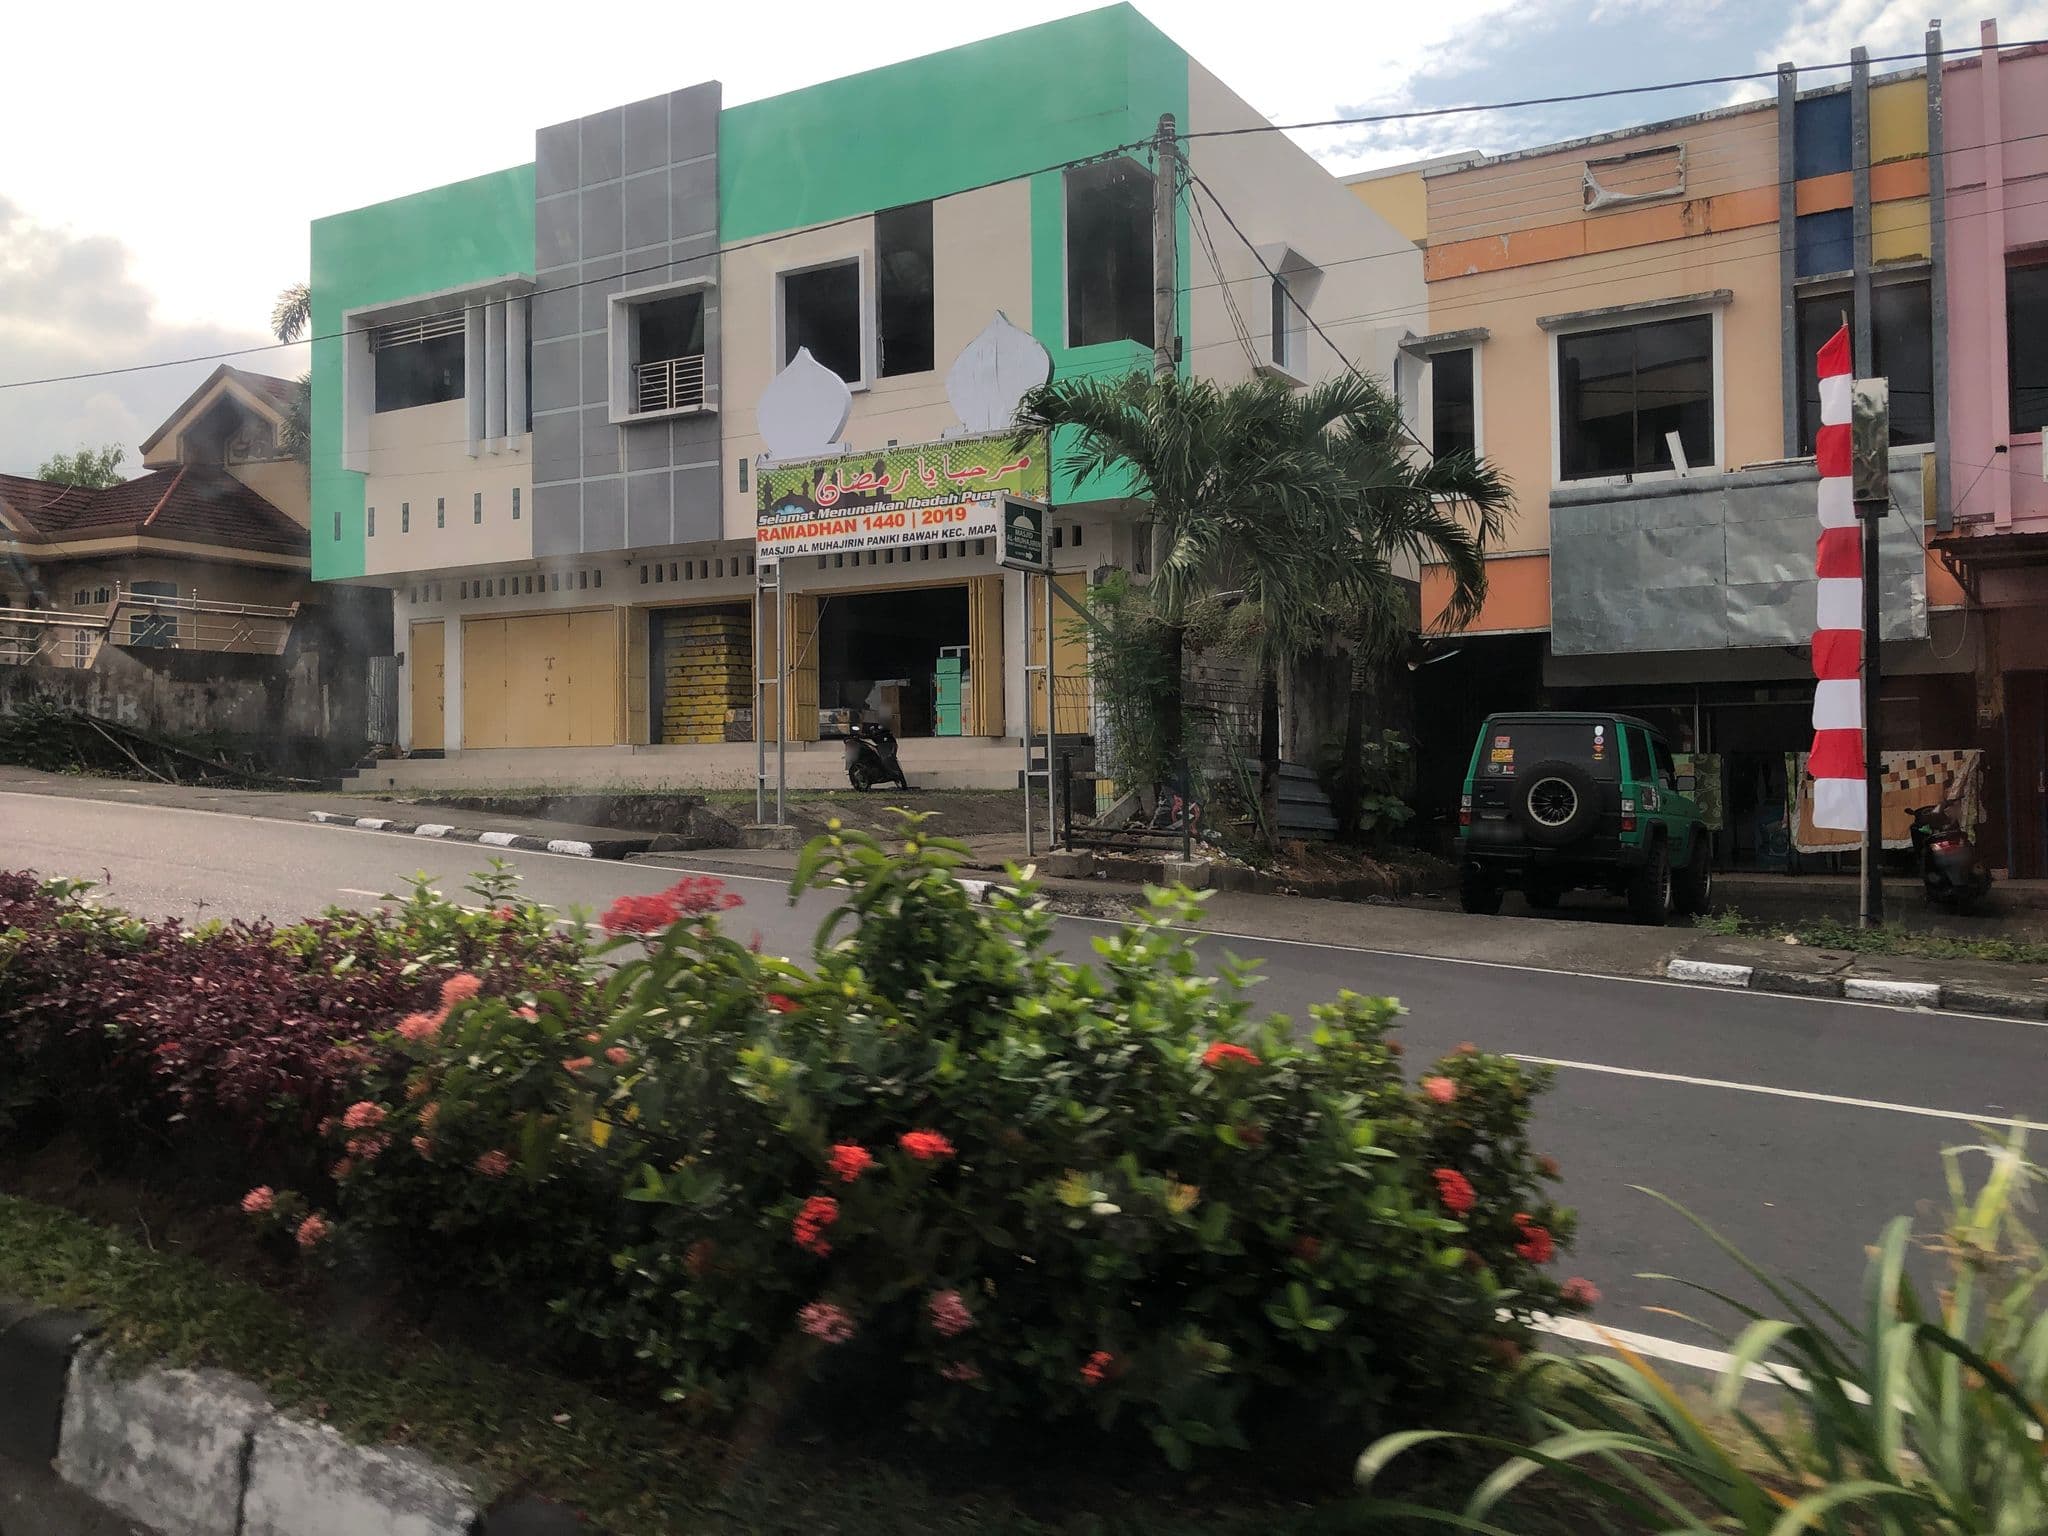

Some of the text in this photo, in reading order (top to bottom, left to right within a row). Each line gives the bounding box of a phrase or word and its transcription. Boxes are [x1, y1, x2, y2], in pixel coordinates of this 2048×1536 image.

[888, 445, 920, 457] Selamat
[922, 441, 953, 453] Datang
[815, 468, 909, 506] رمضان
[917, 457, 937, 487] يا
[757, 517, 857, 542] RAMADHAN
[862, 512, 905, 532] 1440
[922, 506, 967, 525] 2019
[758, 511, 815, 526] Selamat
[817, 499, 905, 520] Menunaikan
[906, 493, 958, 509] Ibadah
[760, 544, 795, 557] MASJID
[797, 543, 809, 553] AL
[811, 537, 865, 552] MUHAJIRIN
[866, 533, 902, 546] PANIKI
[902, 529, 939, 542] BAWAH
[941, 527, 965, 539] KEC.
